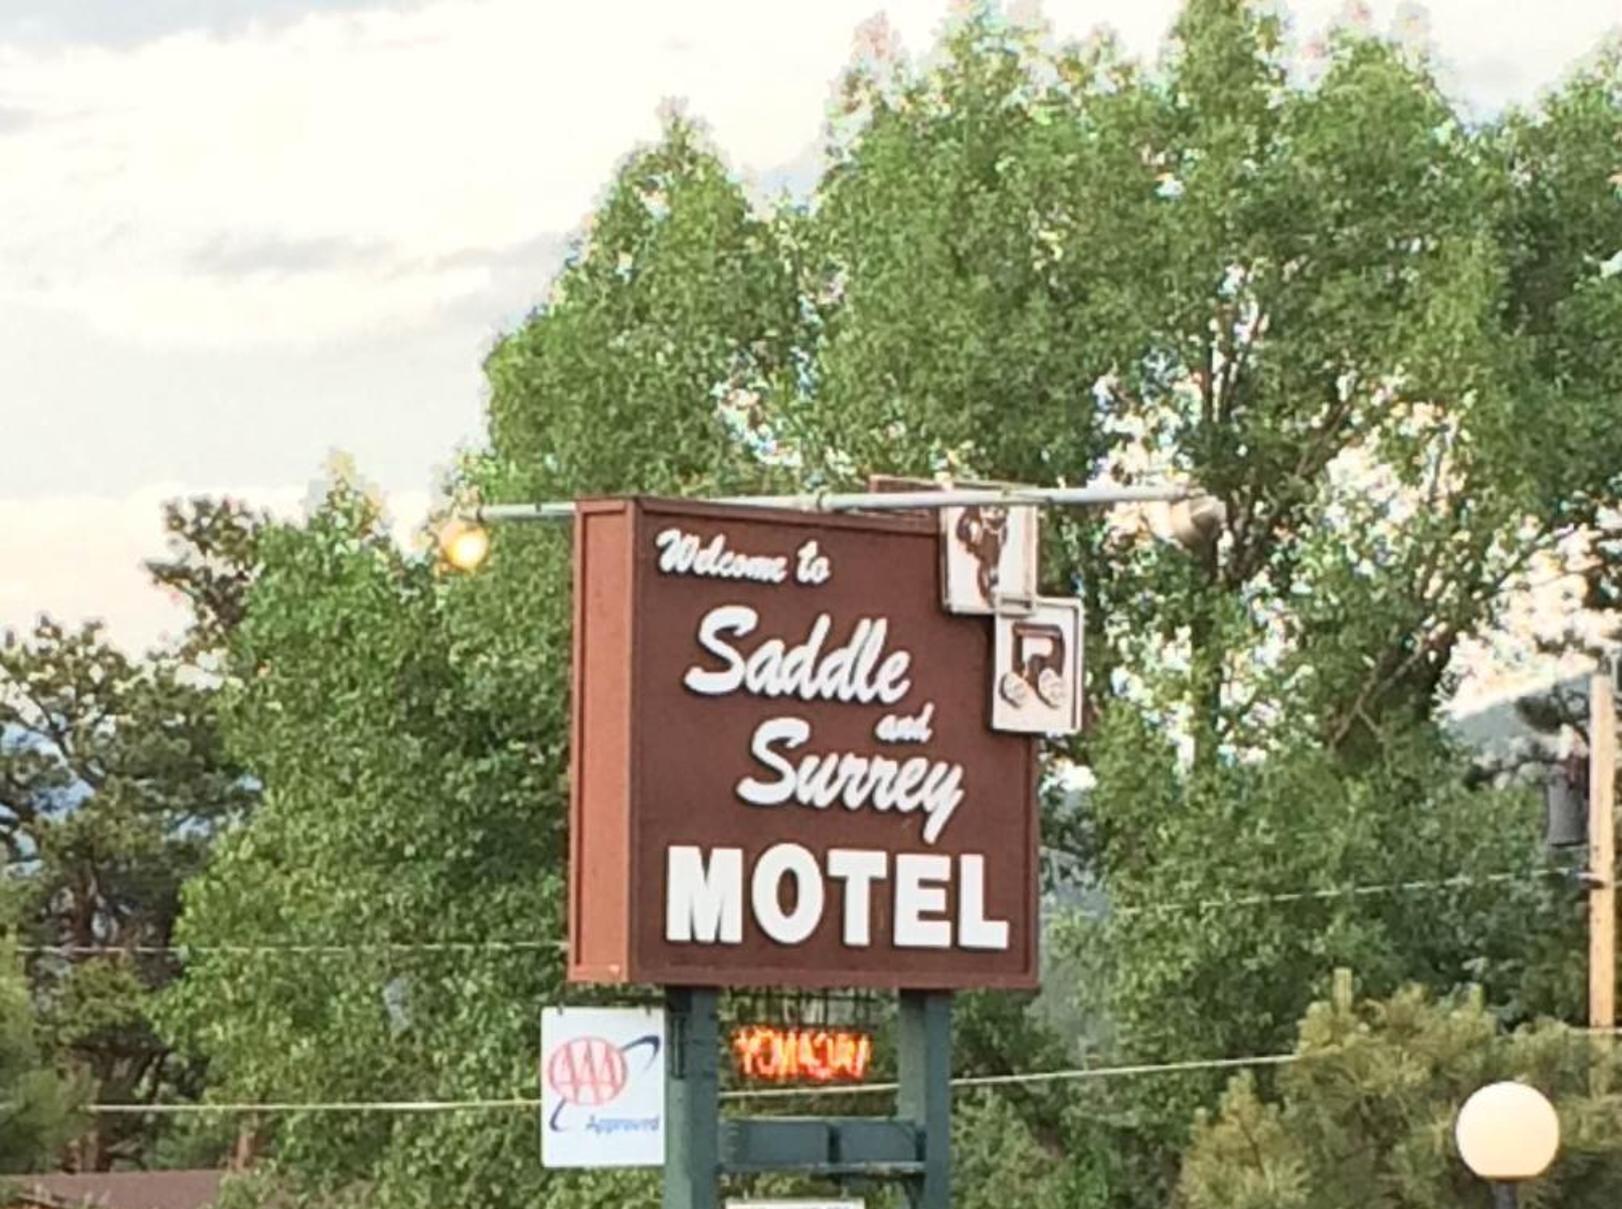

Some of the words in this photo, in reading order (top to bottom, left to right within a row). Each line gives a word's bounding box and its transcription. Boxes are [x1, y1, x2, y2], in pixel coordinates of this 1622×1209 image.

[656, 528, 787, 582] Welcome
[797, 540, 830, 583] to
[684, 605, 911, 703] Saddle
[875, 702, 934, 742] and
[737, 716, 964, 844] Surrey
[666, 843, 1009, 950] MOTEL
[551, 1041, 622, 1104] AAA
[586, 1114, 660, 1135] Approved
